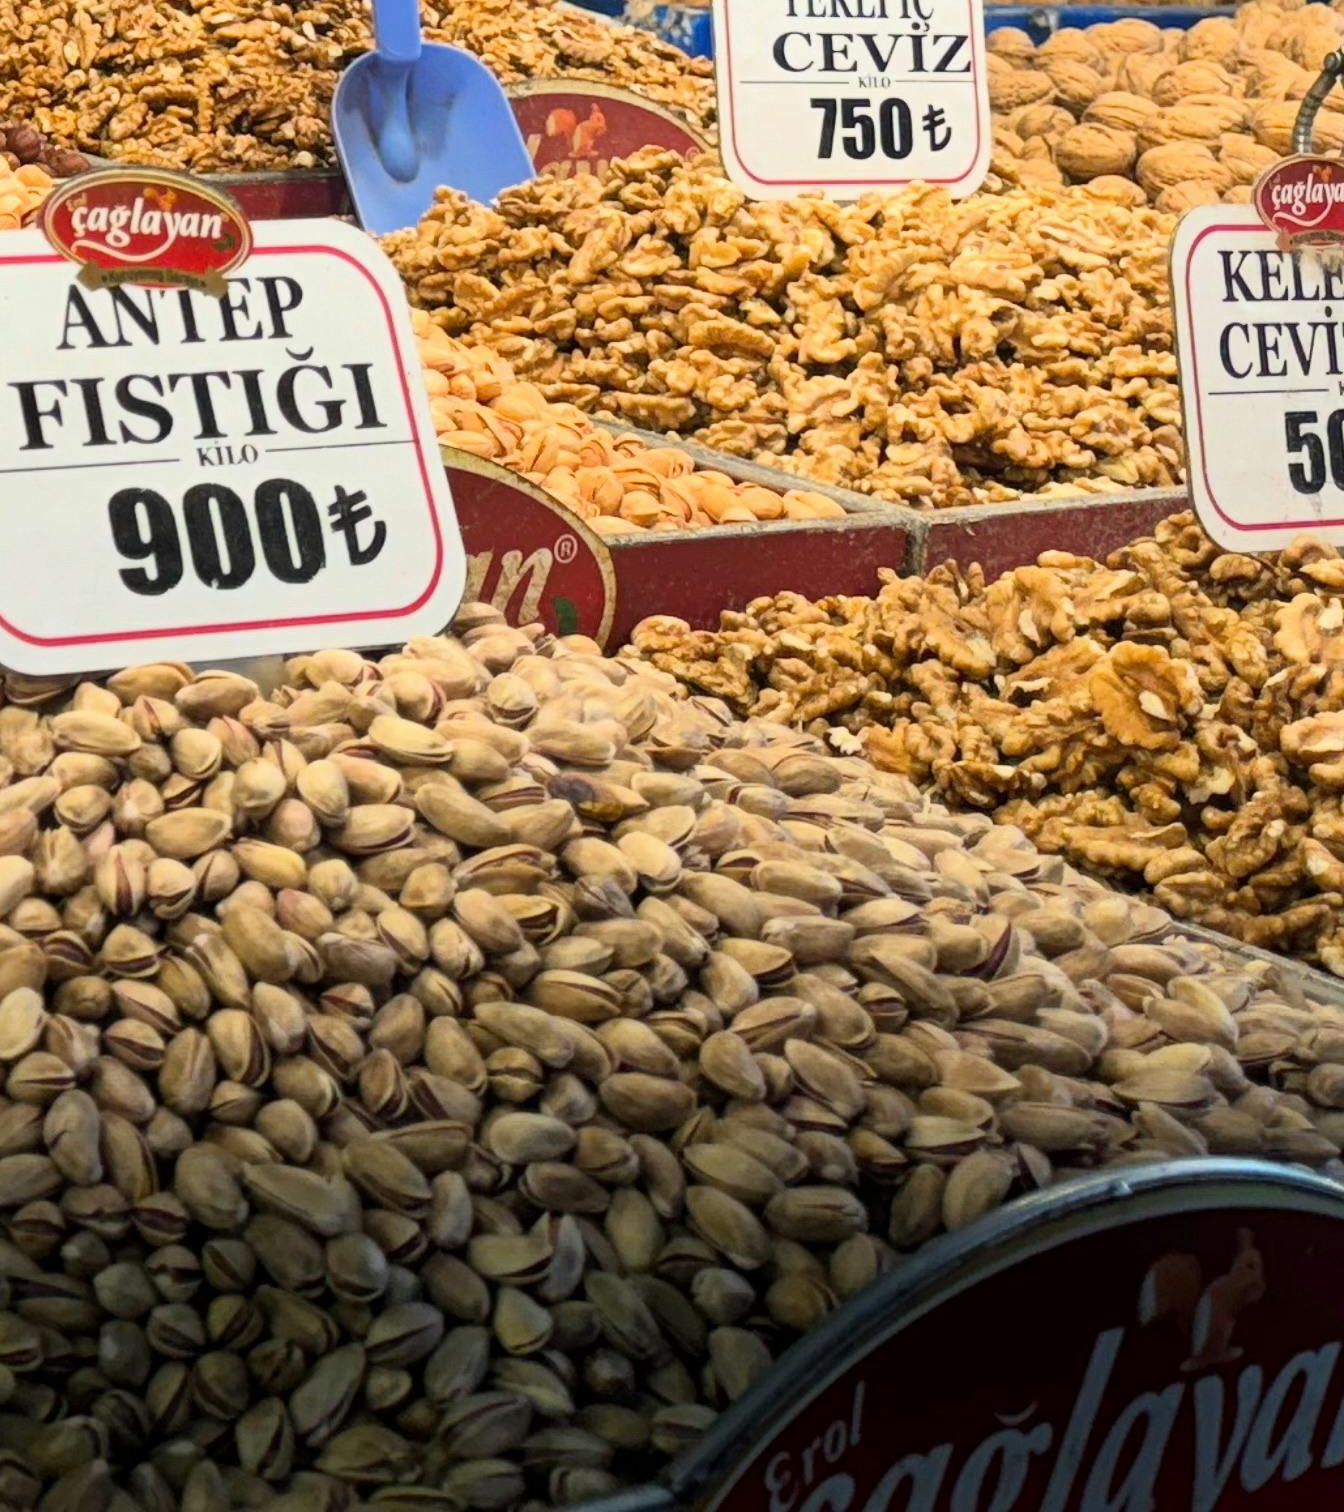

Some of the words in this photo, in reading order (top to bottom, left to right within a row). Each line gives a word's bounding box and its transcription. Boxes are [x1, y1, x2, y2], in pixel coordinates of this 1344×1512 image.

[773, 22, 972, 75] CEVİZ
[1271, 173, 1344, 217] çağlaya
[57, 276, 306, 351] ANTEP
[1220, 305, 1344, 379] CEVİ
[8, 345, 388, 452] FISTIĞI
[198, 440, 260, 468] KİLO
